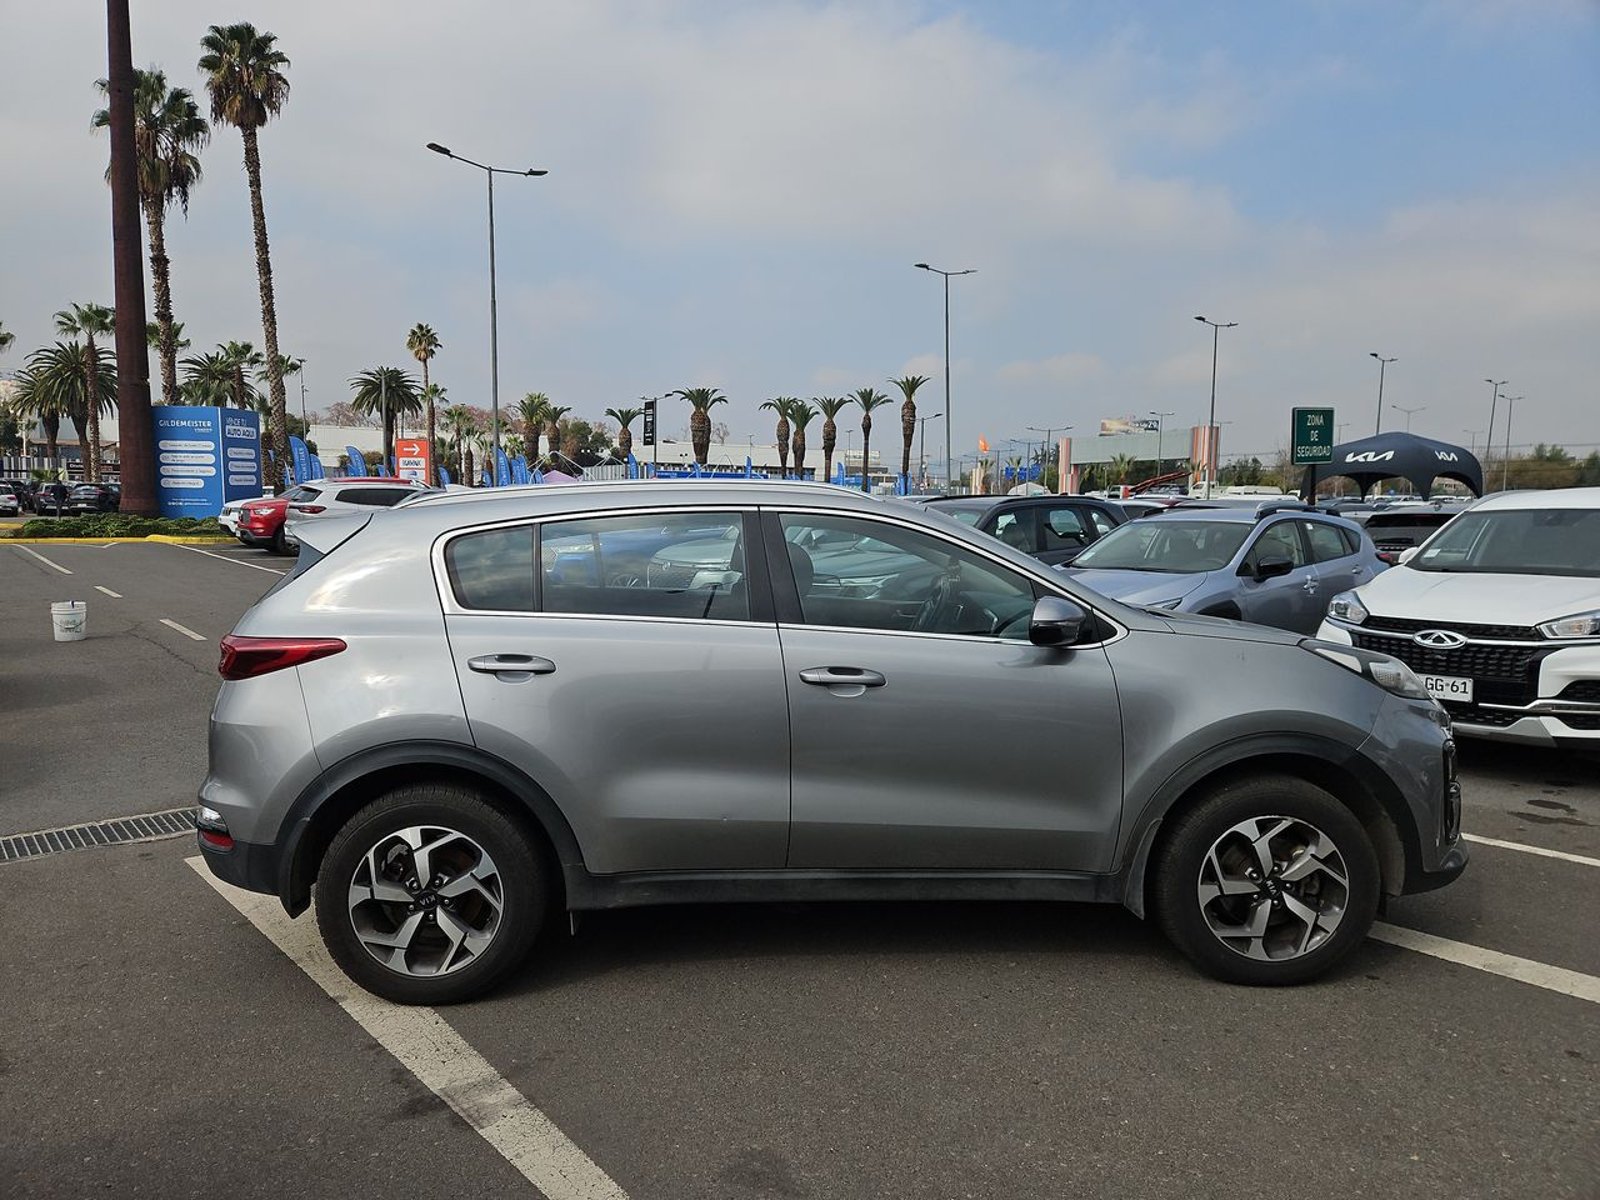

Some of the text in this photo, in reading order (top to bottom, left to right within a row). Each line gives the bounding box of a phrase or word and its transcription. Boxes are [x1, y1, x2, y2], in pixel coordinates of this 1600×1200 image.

[158, 419, 212, 427] GILDEMEISTER
[1306, 414, 1325, 426] ZONA
[1310, 430, 1319, 441] DE
[1297, 445, 1331, 457] SEGURIDAD
